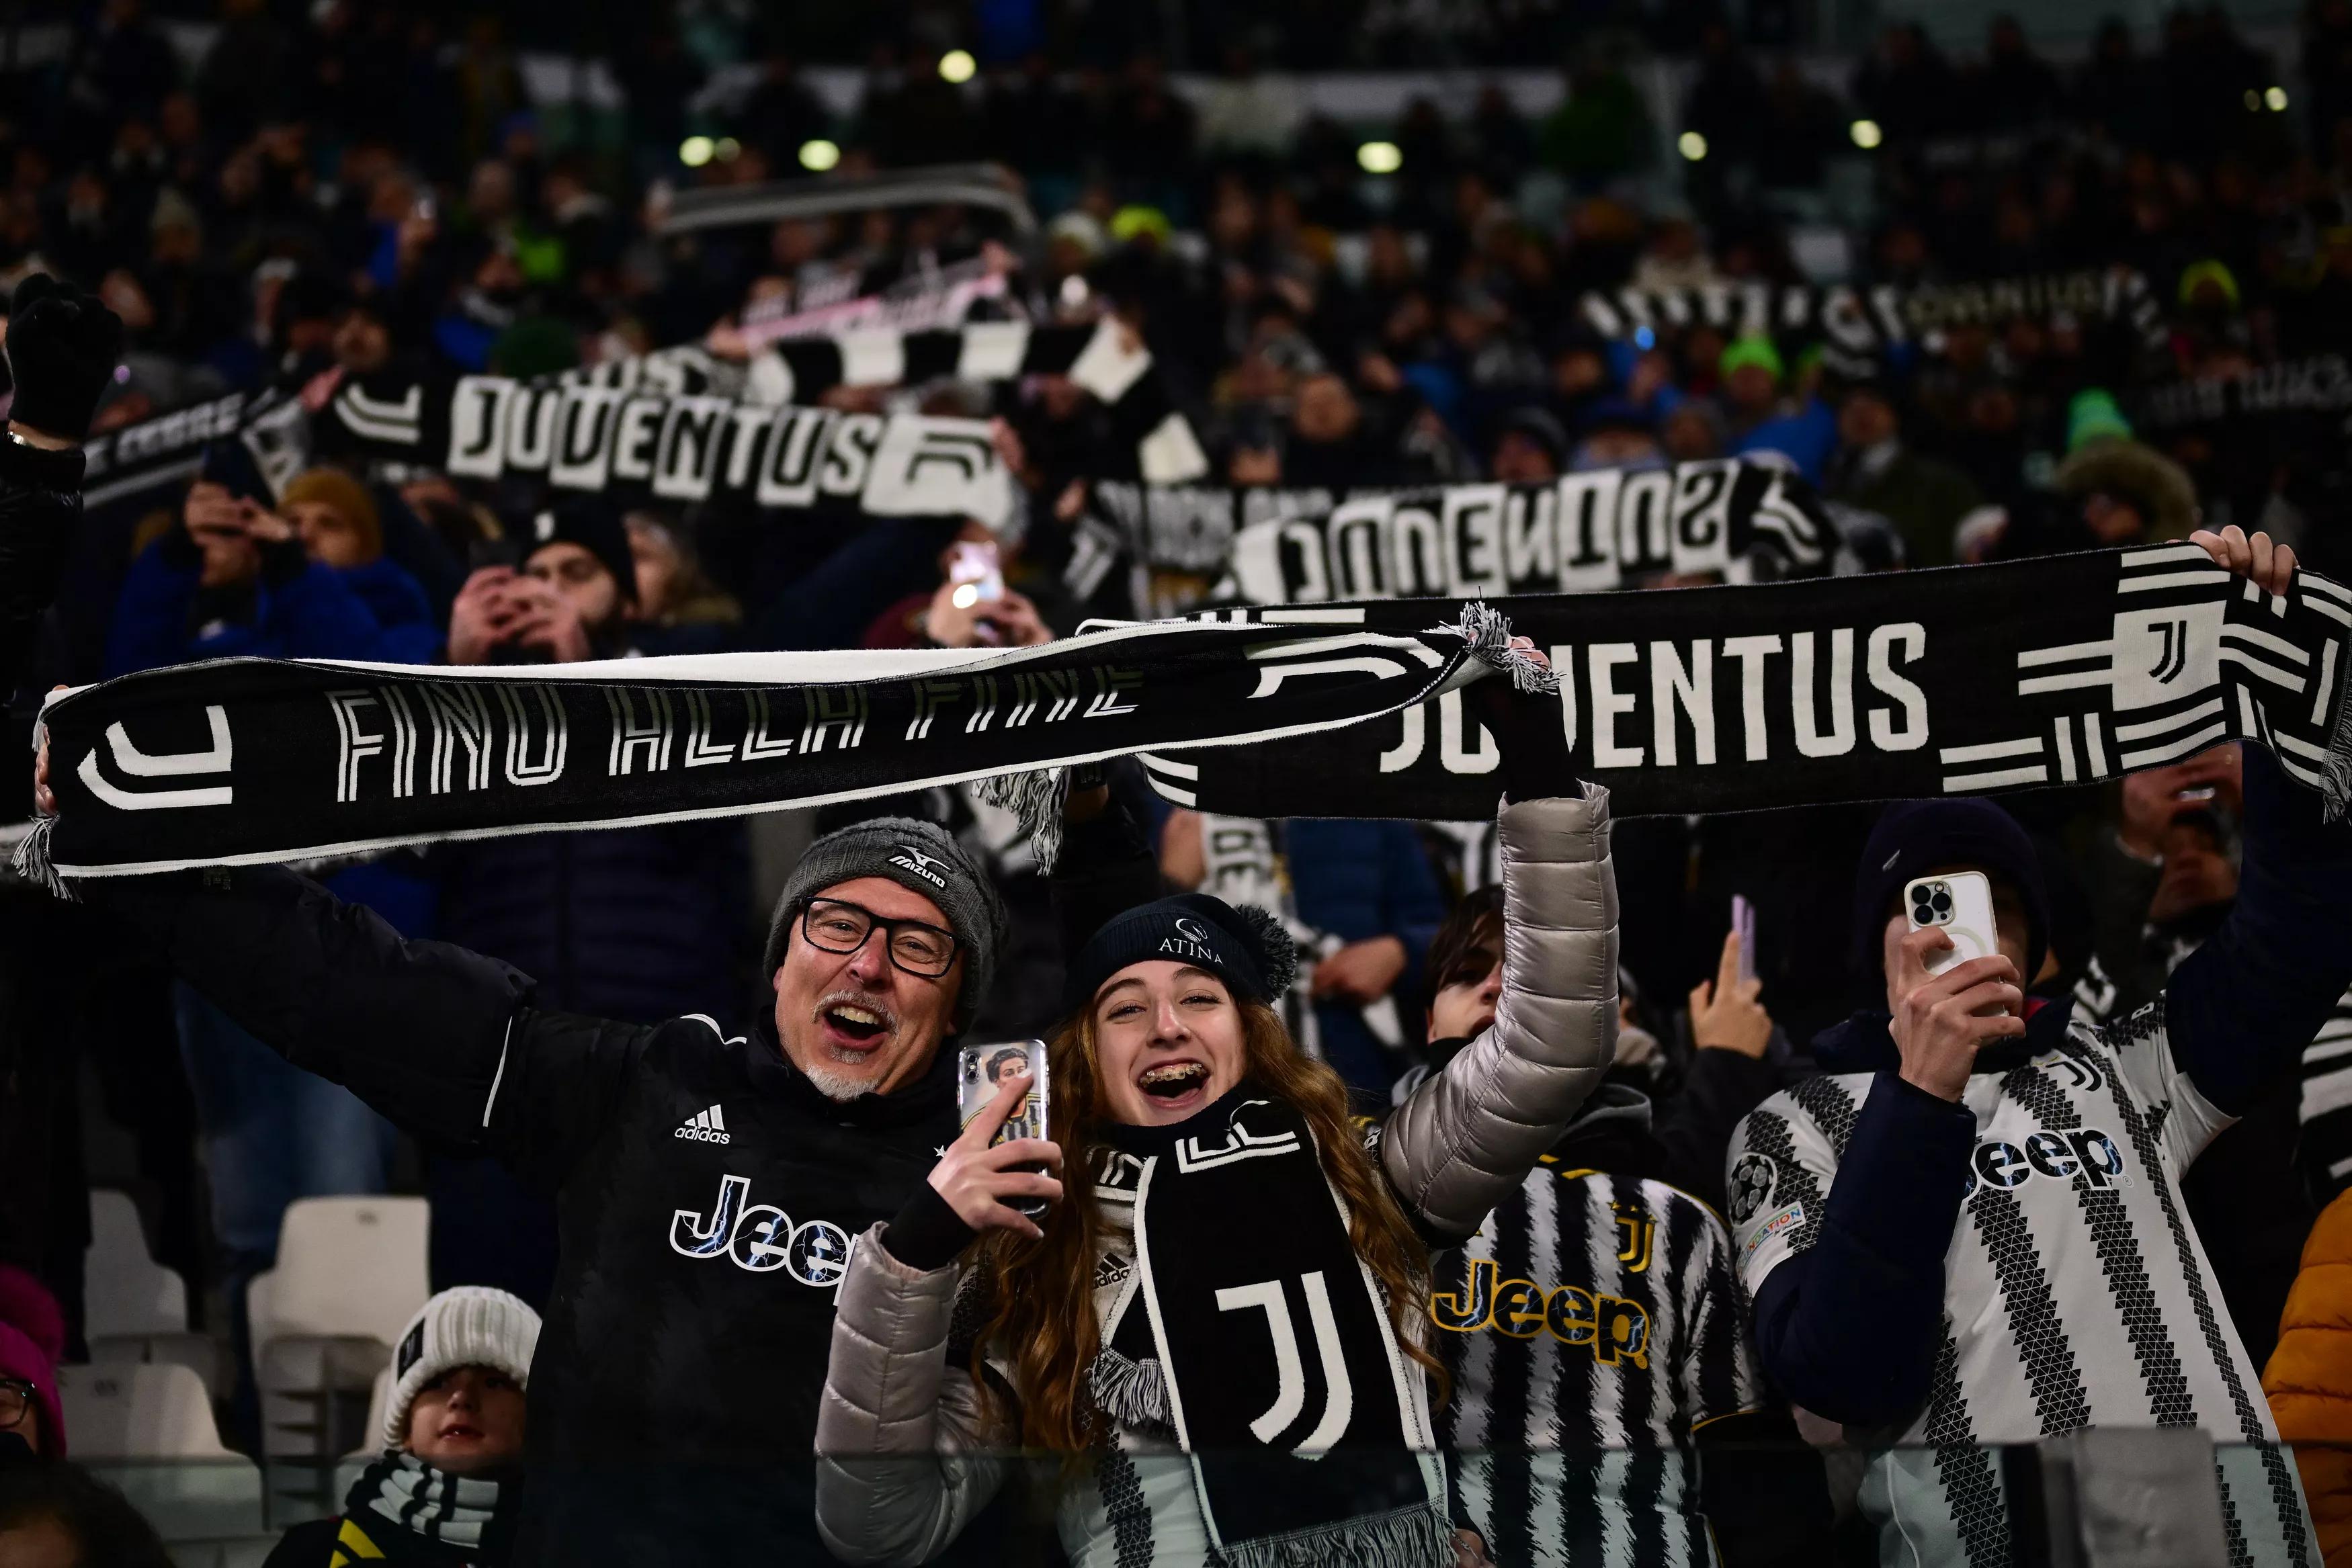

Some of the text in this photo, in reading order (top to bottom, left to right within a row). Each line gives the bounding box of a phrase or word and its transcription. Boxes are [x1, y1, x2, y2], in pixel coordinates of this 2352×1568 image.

[905, 664, 1144, 740] FINE
[1380, 621, 1929, 774] JUENTUS
[888, 855, 946, 888] MIZUNO
[1158, 937, 1224, 965] ATINA
[674, 1126, 731, 1144] adidas
[1966, 1128, 2125, 1193] eep
[669, 1174, 860, 1307] Jee
[1091, 1269, 1130, 1290] adida
[1430, 1258, 1651, 1368] Jeep
